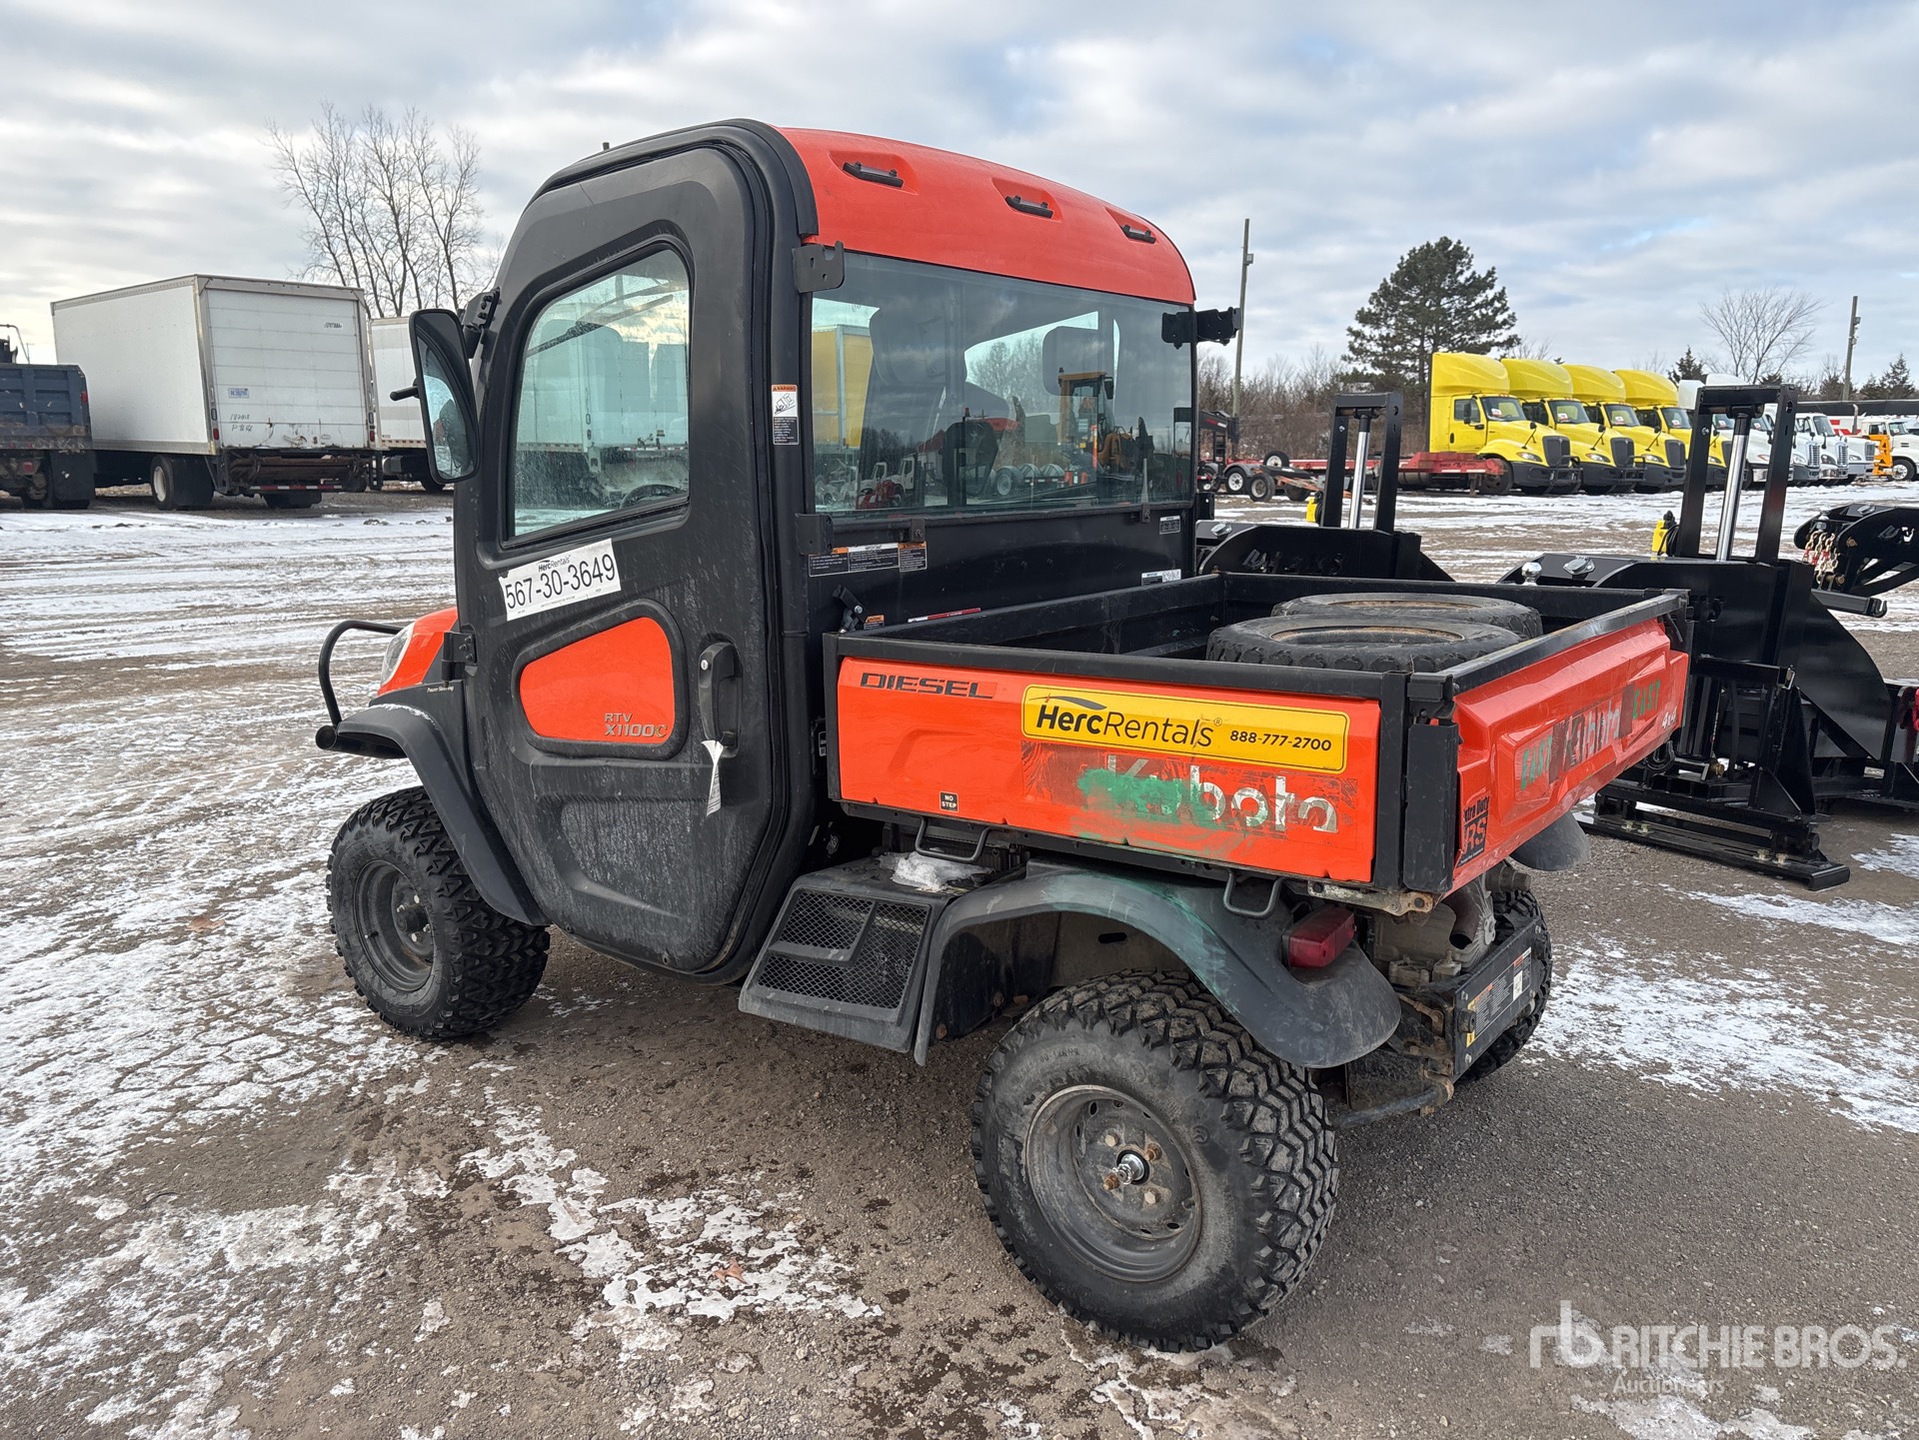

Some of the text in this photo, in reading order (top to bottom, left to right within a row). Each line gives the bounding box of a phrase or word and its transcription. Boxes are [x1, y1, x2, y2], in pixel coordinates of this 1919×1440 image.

[505, 554, 615, 609] 567-30-3649
[860, 672, 993, 699] DIESEL
[1632, 680, 1661, 719] EAST
[604, 712, 632, 723] RTV
[604, 723, 668, 738] X1100C
[1036, 703, 1332, 752] HercRentals 888-777-2700
[941, 801, 957, 809] STEP
